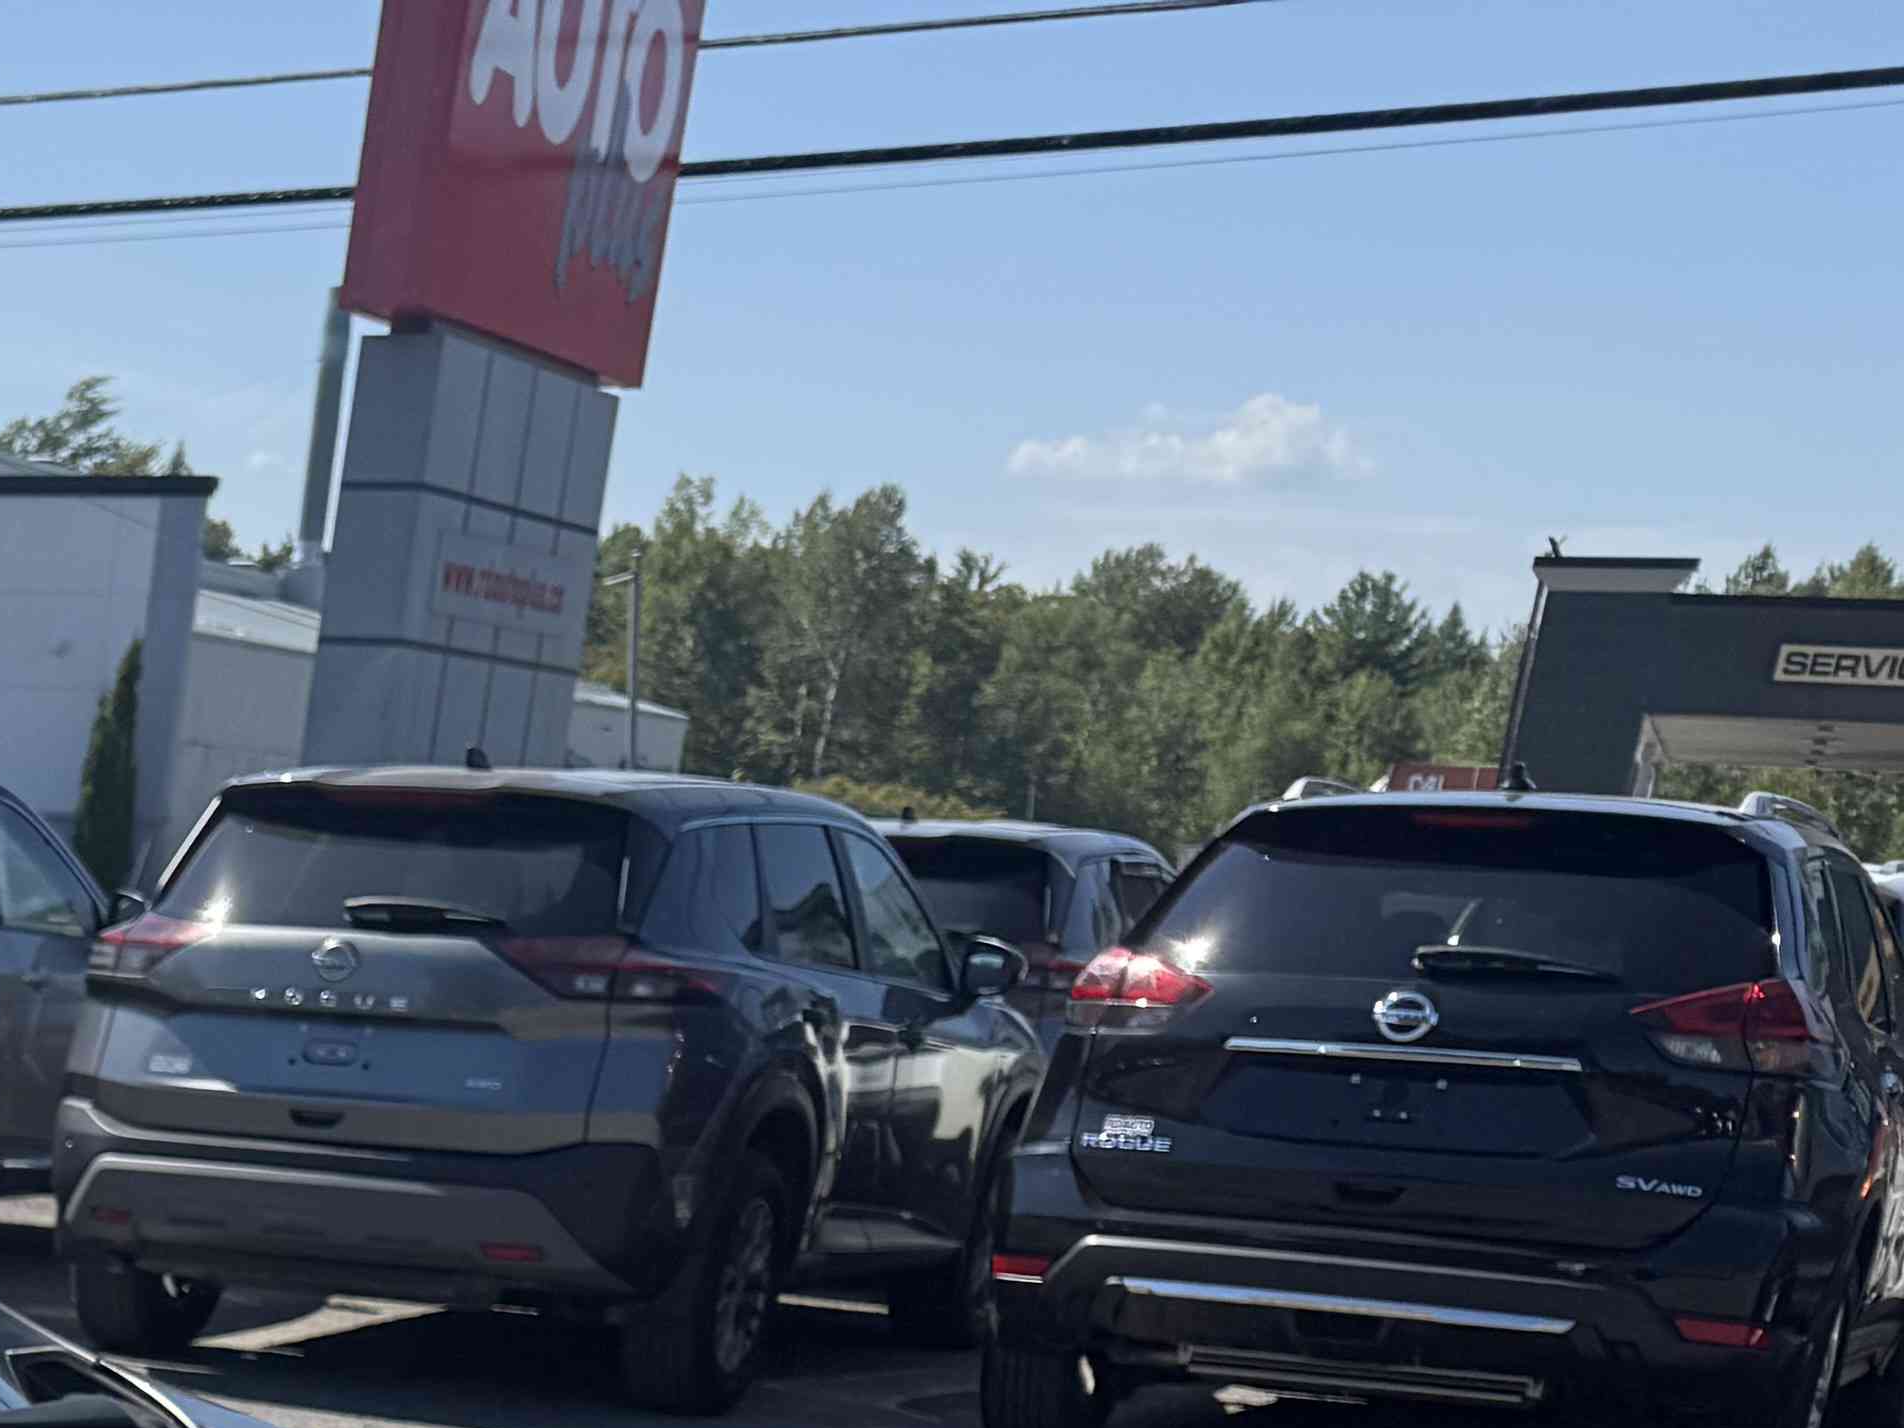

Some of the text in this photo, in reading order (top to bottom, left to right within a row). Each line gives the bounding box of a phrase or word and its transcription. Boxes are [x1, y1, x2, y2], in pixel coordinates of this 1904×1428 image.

[468, 0, 684, 183] AUTO
[1082, 1132, 1171, 1153] ROGUE
[1616, 1176, 1703, 1198] SV AWD
